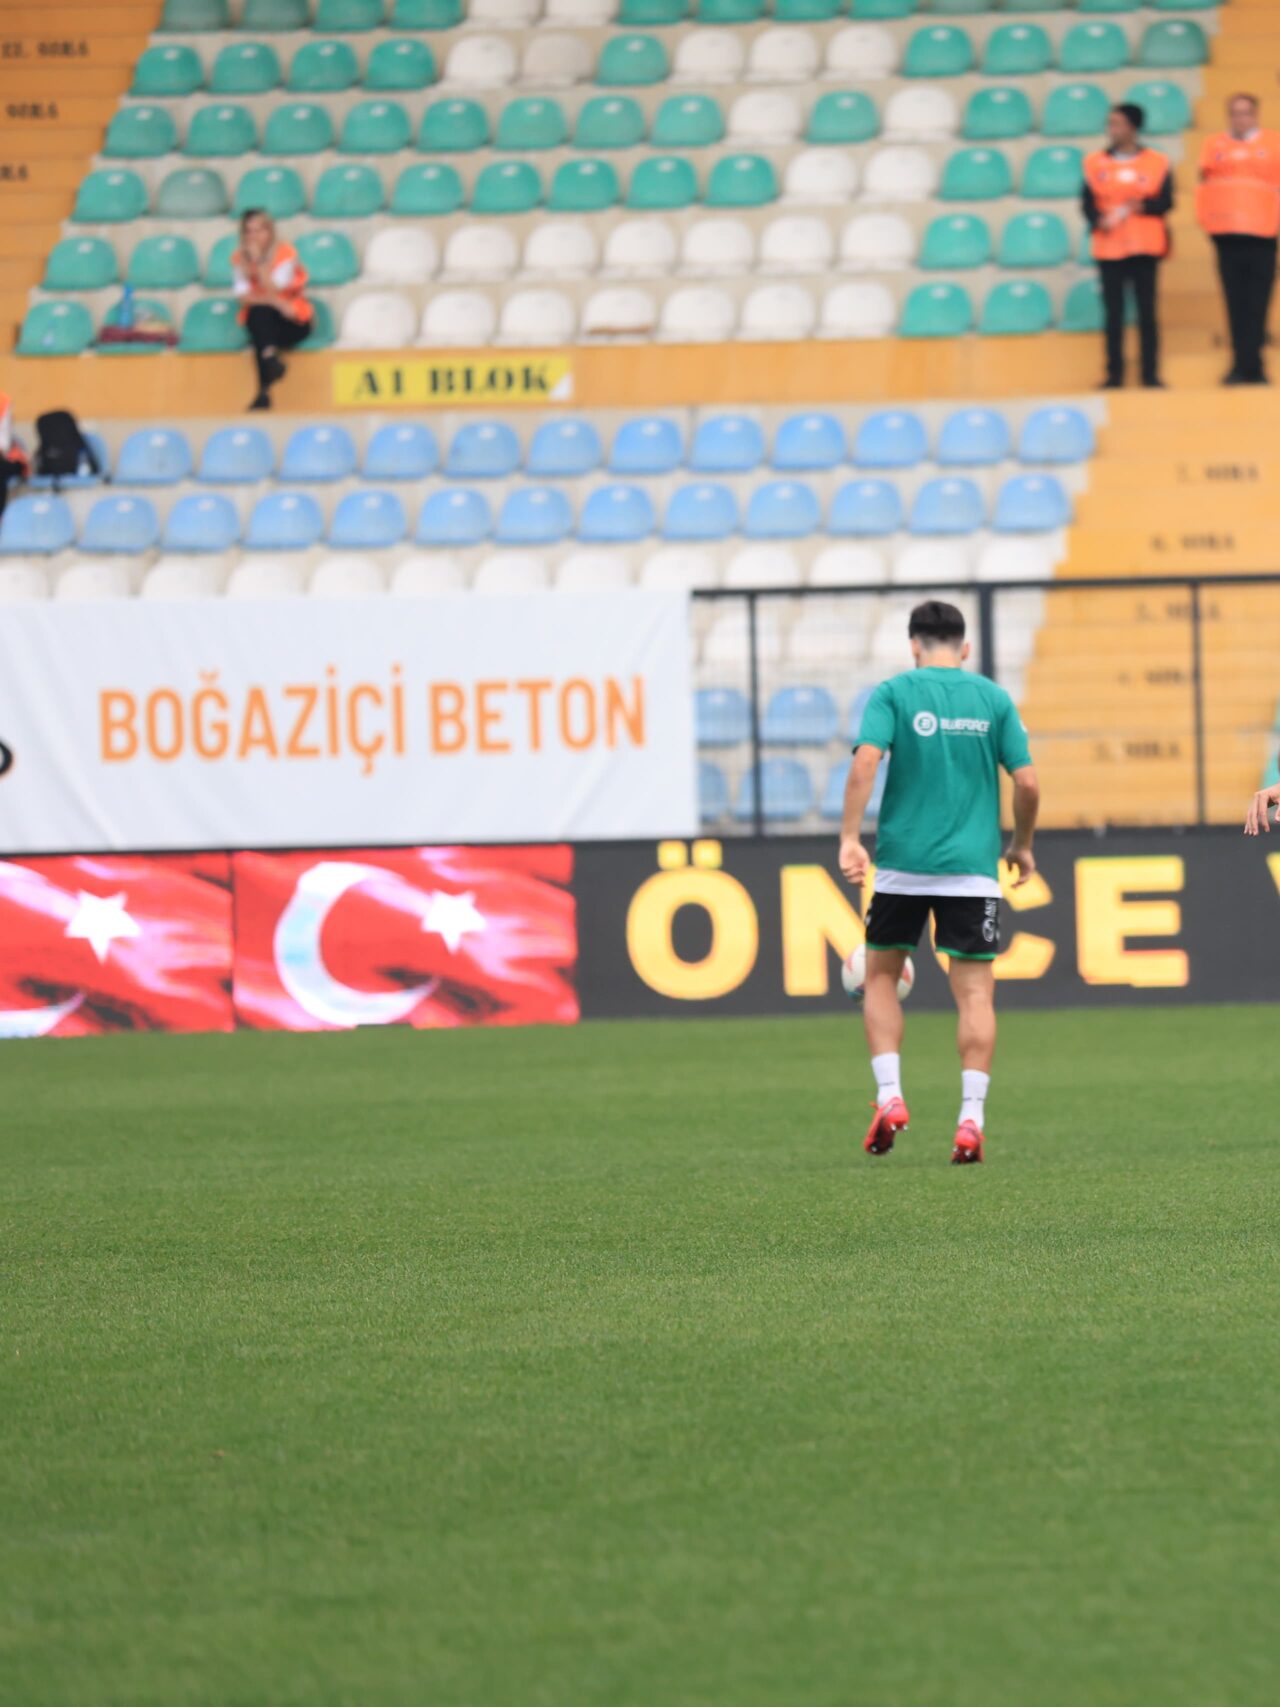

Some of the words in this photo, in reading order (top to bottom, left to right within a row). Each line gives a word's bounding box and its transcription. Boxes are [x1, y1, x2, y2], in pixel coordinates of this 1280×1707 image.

[354, 368, 404, 400] A1
[430, 364, 550, 396] BLOK
[98, 663, 406, 777] BOĞAZİÇİ
[428, 674, 646, 756] BETON
